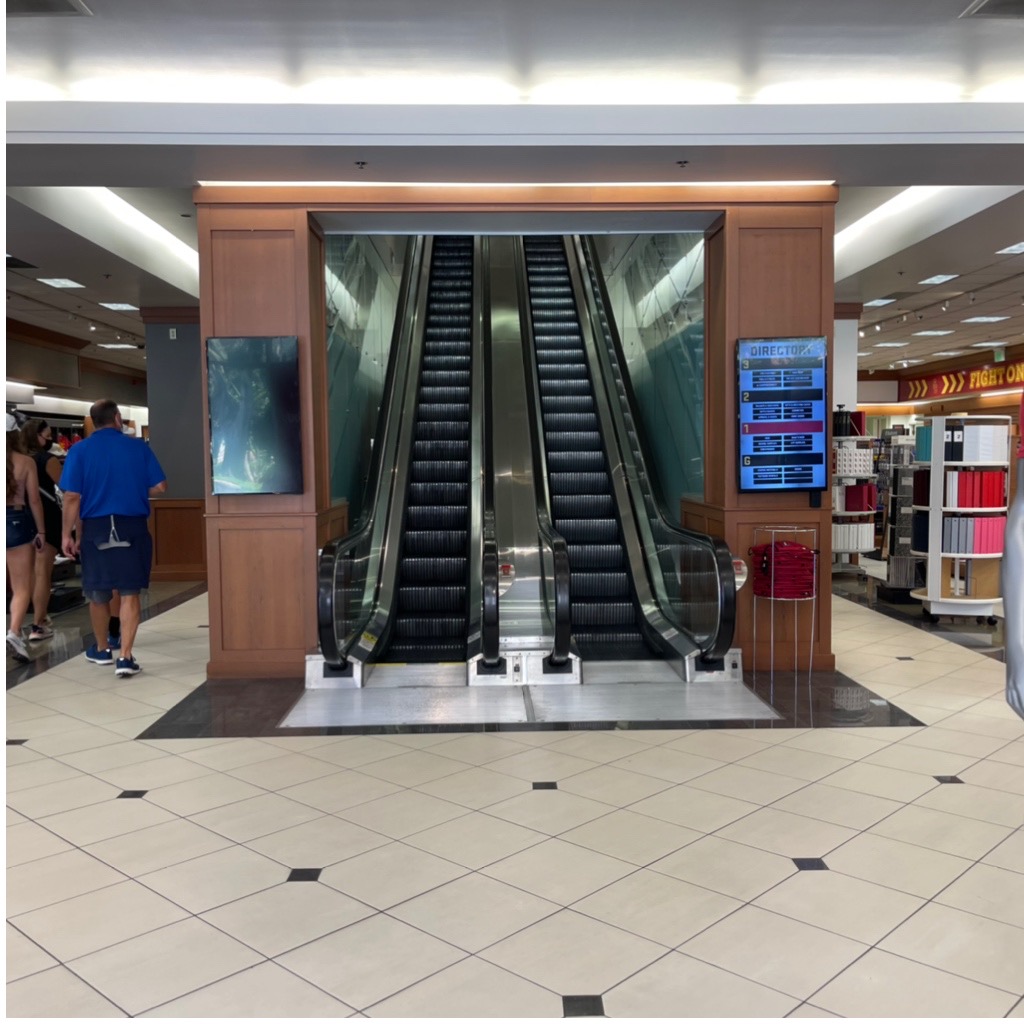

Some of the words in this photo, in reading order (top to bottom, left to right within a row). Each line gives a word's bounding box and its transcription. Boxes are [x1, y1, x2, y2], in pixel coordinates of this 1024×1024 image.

[751, 345, 811, 357] DIRECTORY
[743, 360, 750, 369] 3
[969, 367, 1005, 389] FIGHT
[743, 392, 750, 401] 2
[743, 424, 749, 433] 1
